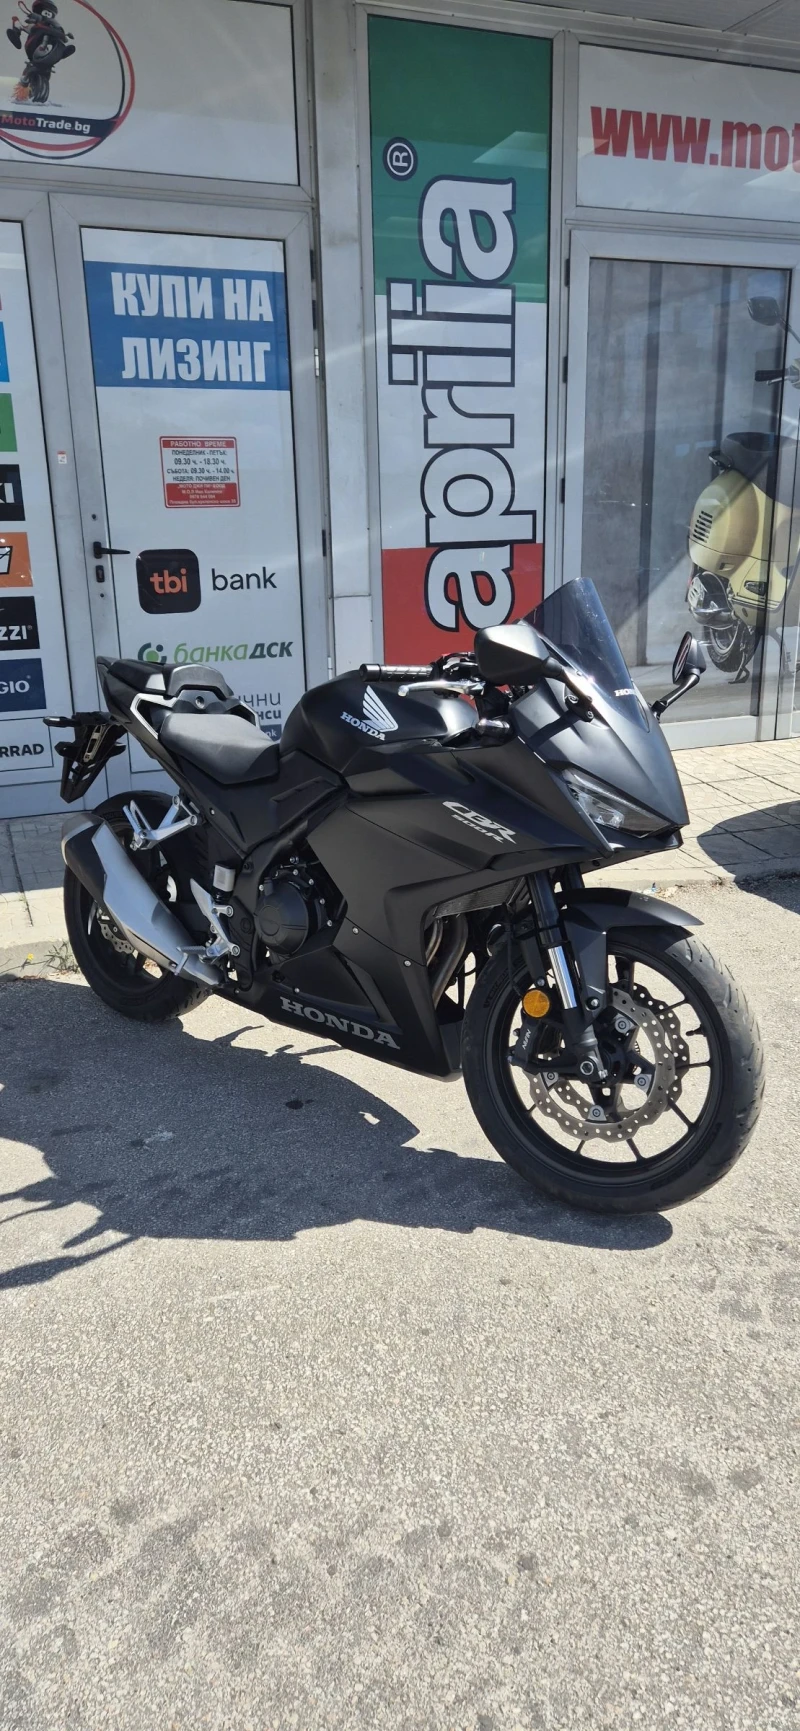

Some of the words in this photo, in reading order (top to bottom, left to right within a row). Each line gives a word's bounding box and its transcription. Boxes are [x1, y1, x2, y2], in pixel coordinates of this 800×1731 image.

[1, 114, 91, 134] MotoTrade.bg
[111, 271, 214, 320] КУПИ
[222, 277, 273, 322] НА
[121, 336, 271, 382] ЛИЗИНГ
[387, 174, 536, 632] aprilia
[170, 440, 201, 448] РАБОТНО
[174, 457, 191, 465] 09.30
[203, 458, 220, 466] 18.30
[150, 567, 189, 595] tbi
[211, 566, 278, 592] bank
[339, 711, 387, 741] HONDA
[0, 743, 45, 758] RRAD
[442, 801, 518, 845] CBR
[280, 996, 401, 1050] HONDA
